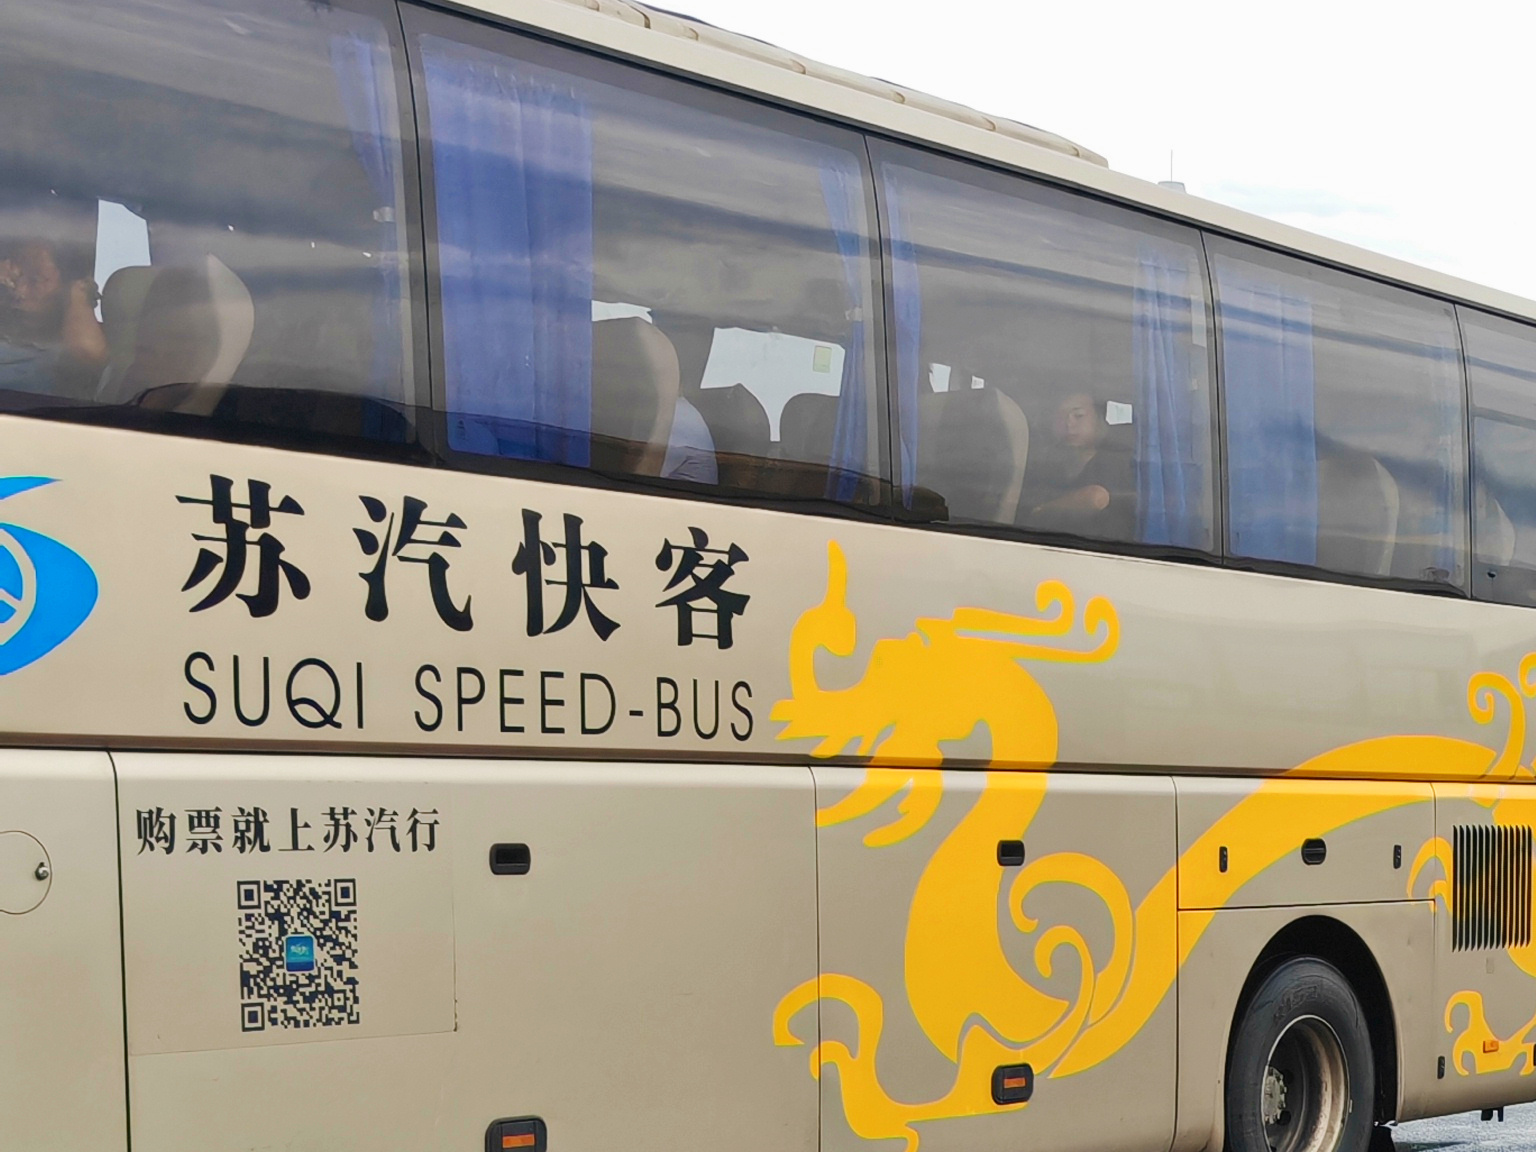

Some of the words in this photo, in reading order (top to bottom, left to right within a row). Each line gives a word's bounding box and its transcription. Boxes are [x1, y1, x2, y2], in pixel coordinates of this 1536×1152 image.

[175, 474, 751, 650] 苏汽快客
[183, 651, 364, 730] SUQI
[414, 664, 754, 742] SPEED-BUS
[136, 806, 441, 856] 购票就上苏汽行
